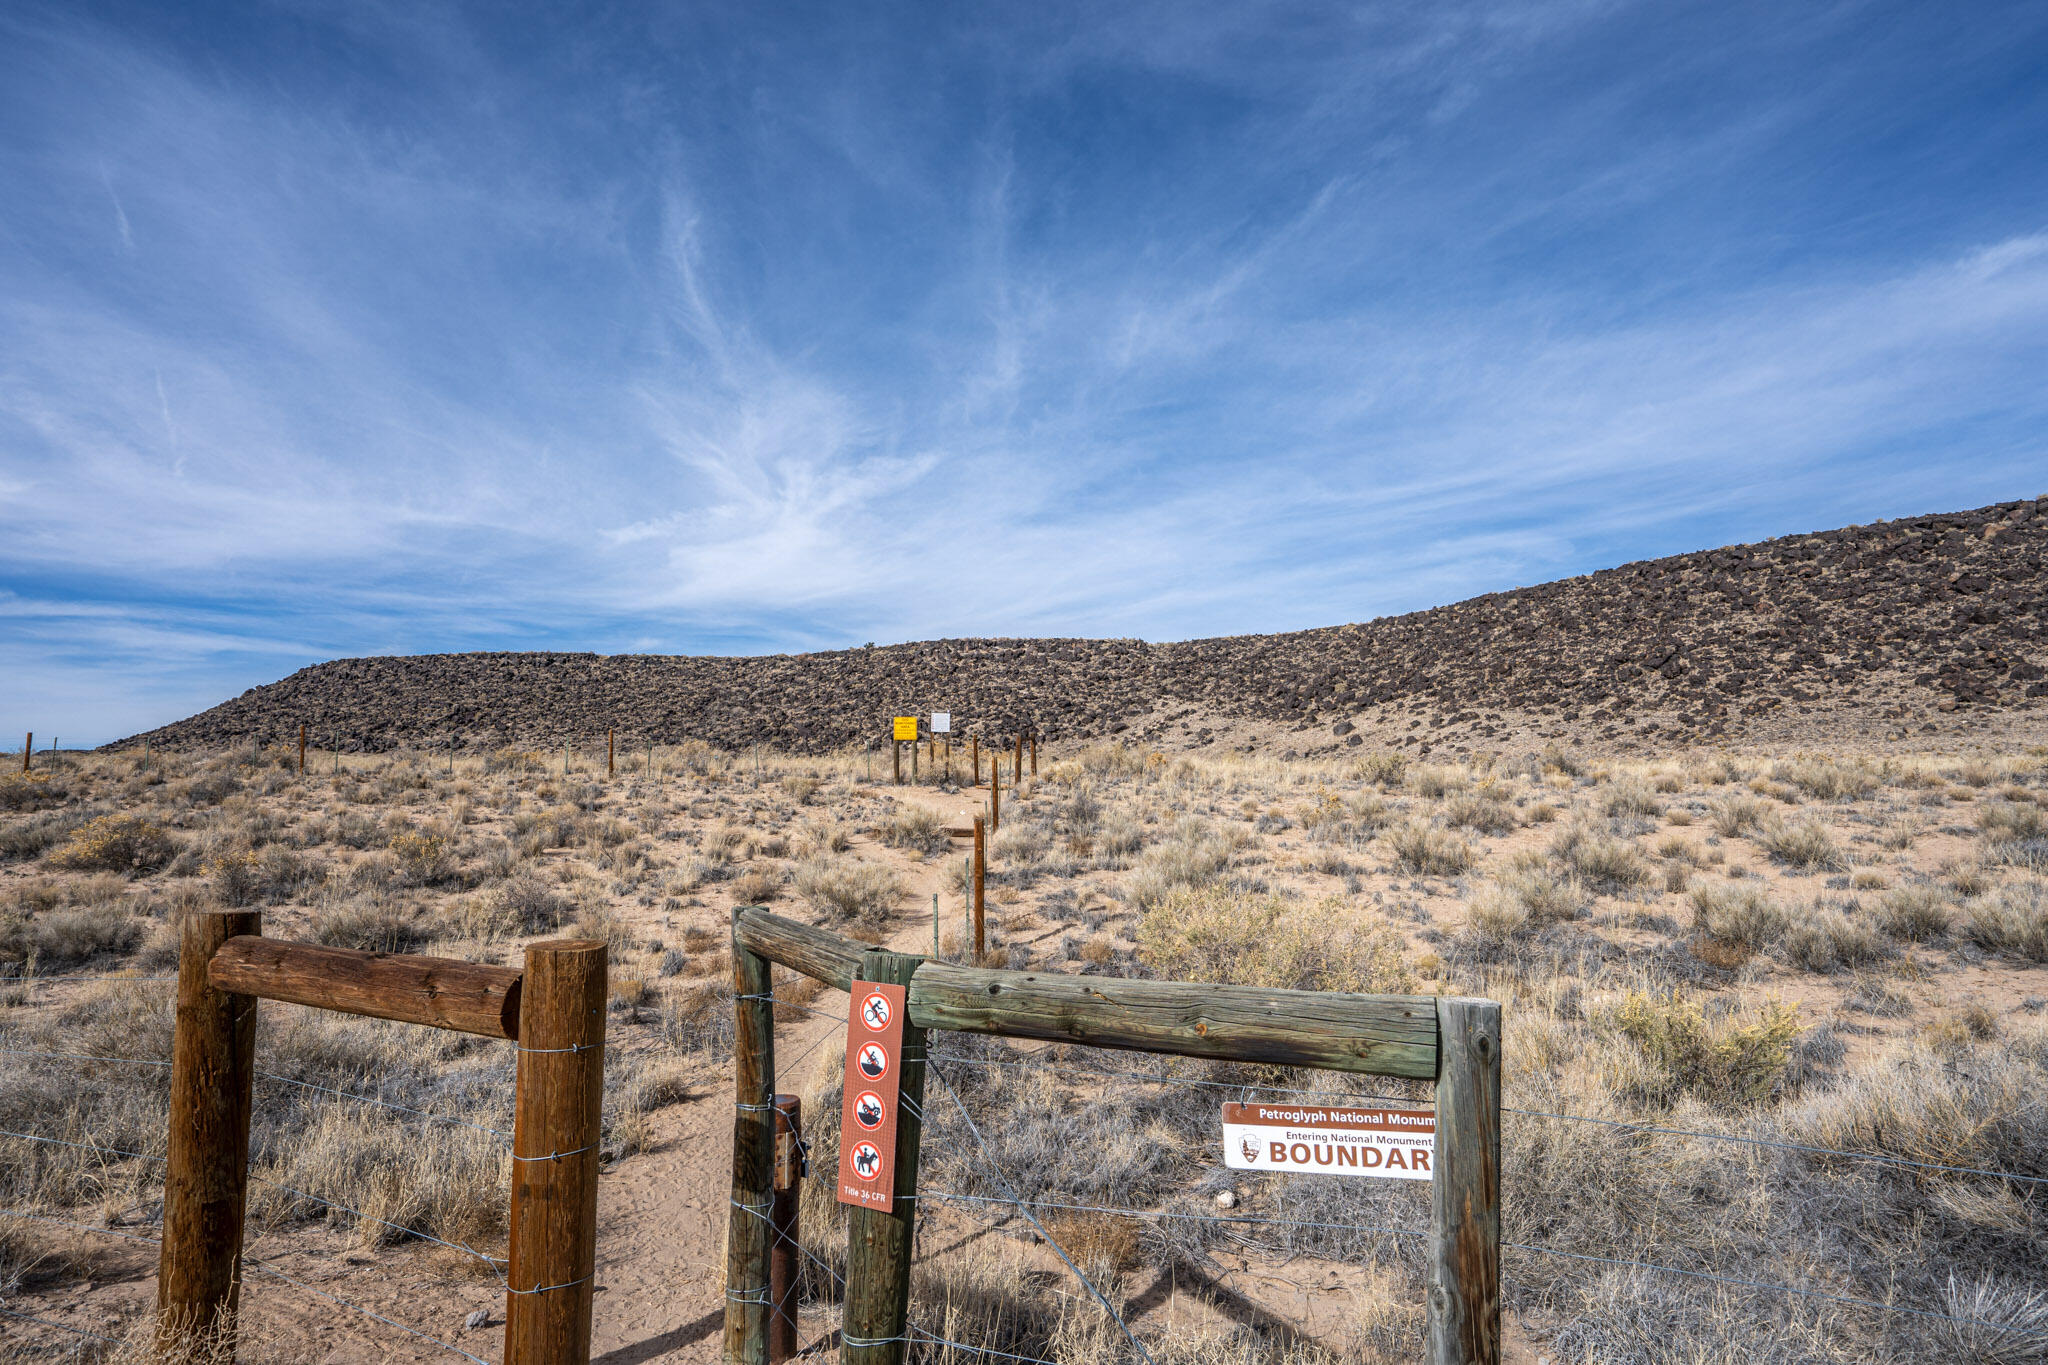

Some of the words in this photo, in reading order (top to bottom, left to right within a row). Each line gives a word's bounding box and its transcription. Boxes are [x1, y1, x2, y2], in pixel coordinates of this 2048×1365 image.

[1259, 1108, 1327, 1123] Petroglyph
[1330, 1110, 1383, 1124] National
[1286, 1131, 1328, 1144] Entering
[1331, 1133, 1373, 1144] National
[1376, 1135, 1433, 1147] Monument
[1269, 1141, 1434, 1171] BOUNDAR
[844, 1185, 859, 1197] Title
[861, 1189, 870, 1199] 36
[871, 1192, 886, 1203] CFR
